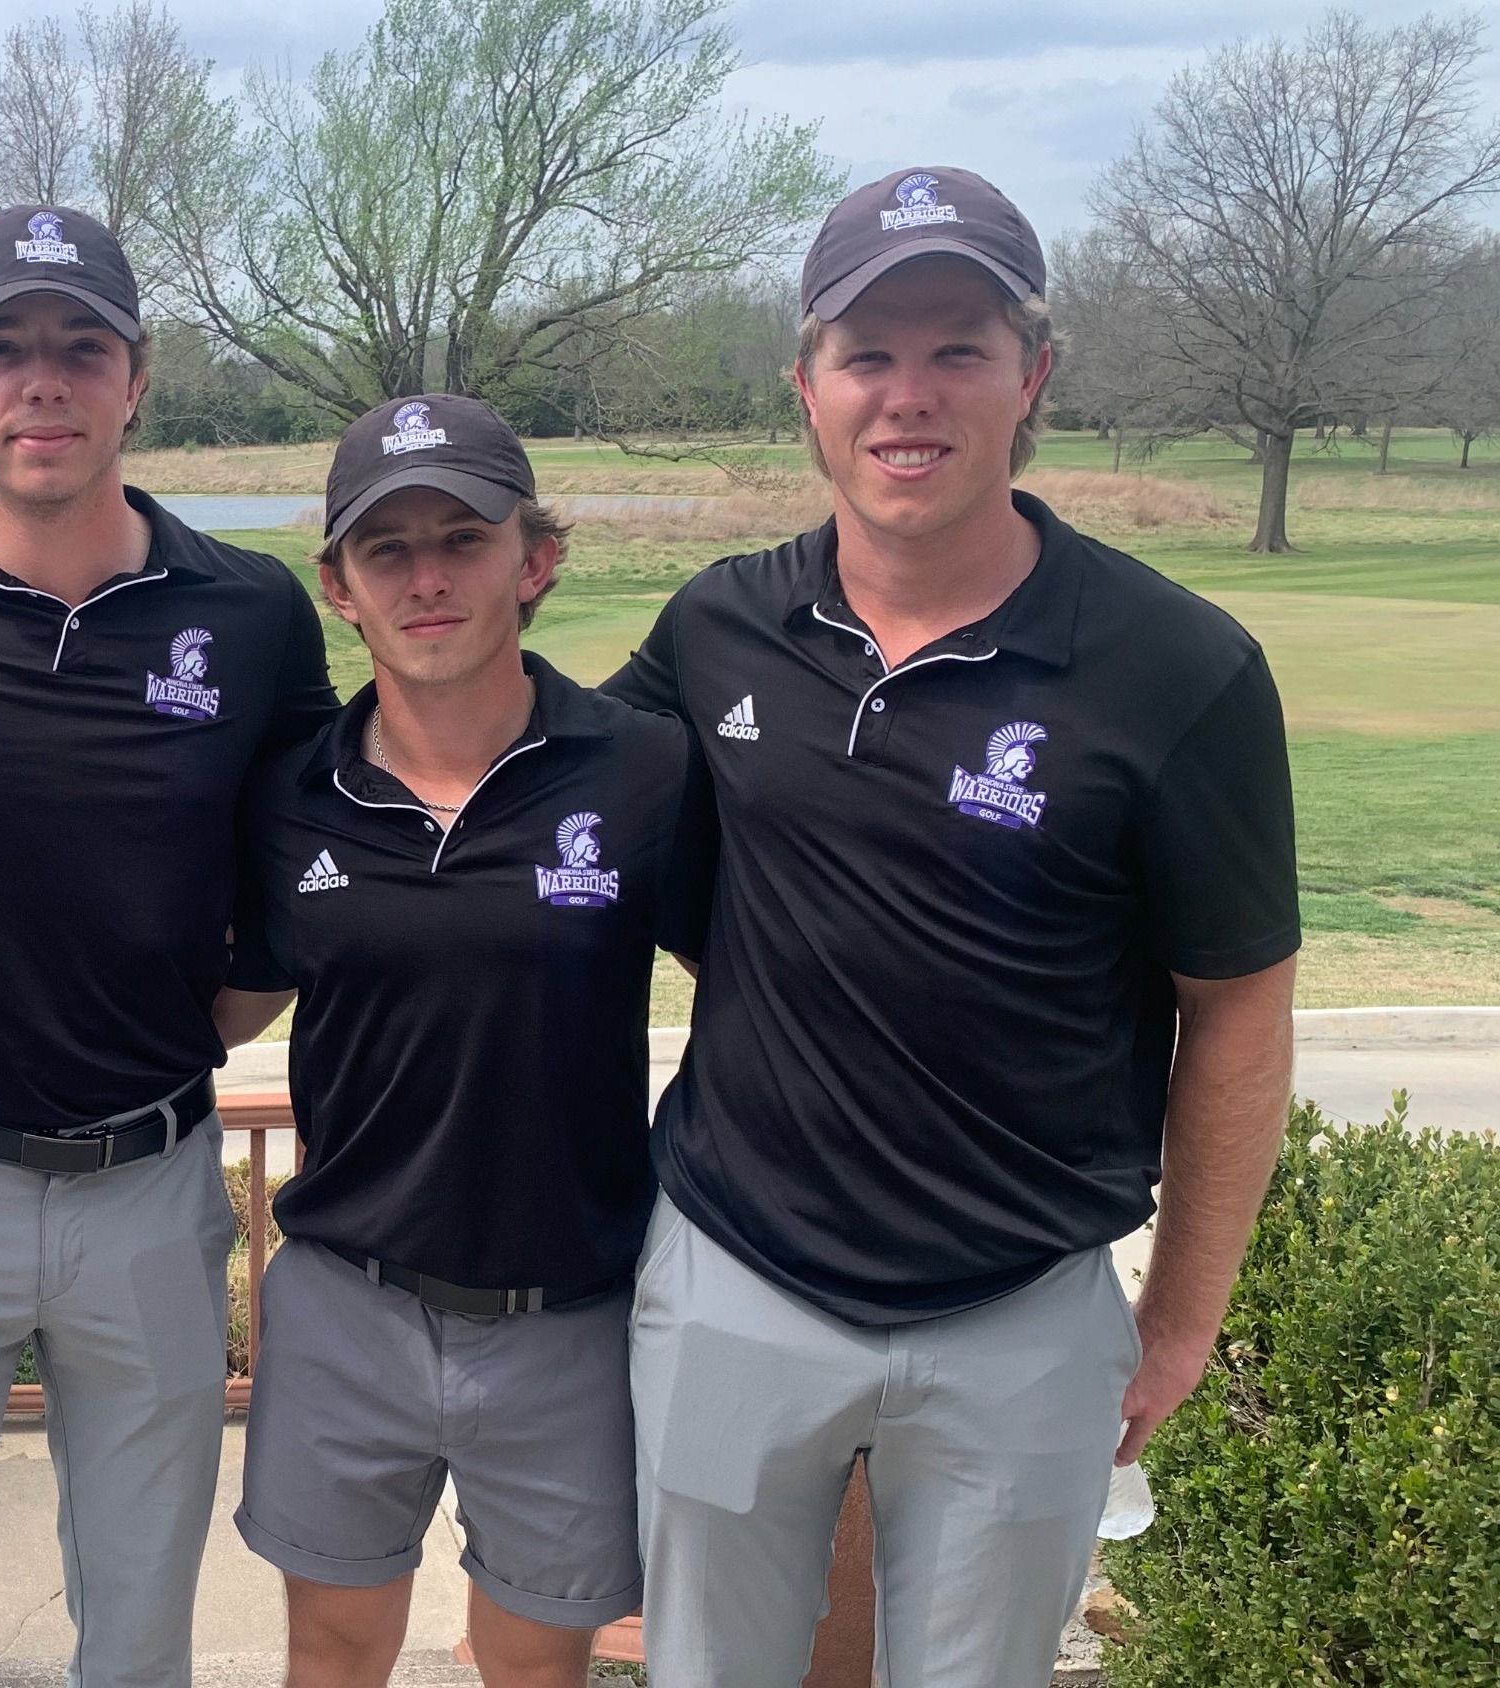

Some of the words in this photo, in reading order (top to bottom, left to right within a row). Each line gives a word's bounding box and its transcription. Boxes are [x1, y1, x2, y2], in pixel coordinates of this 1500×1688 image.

[882, 205, 957, 229] WARRIORS
[16, 241, 78, 262] WARRIORS
[383, 430, 446, 454] WARRIORS
[146, 673, 220, 716] WARRIORS
[171, 706, 190, 716] GOLF
[717, 719, 760, 741] adidas
[949, 768, 1046, 825] WARRIORS
[978, 808, 1002, 821] GOLF
[298, 873, 350, 894] adidas
[536, 867, 619, 900] WARRIORS
[568, 896, 589, 905] GOLF
